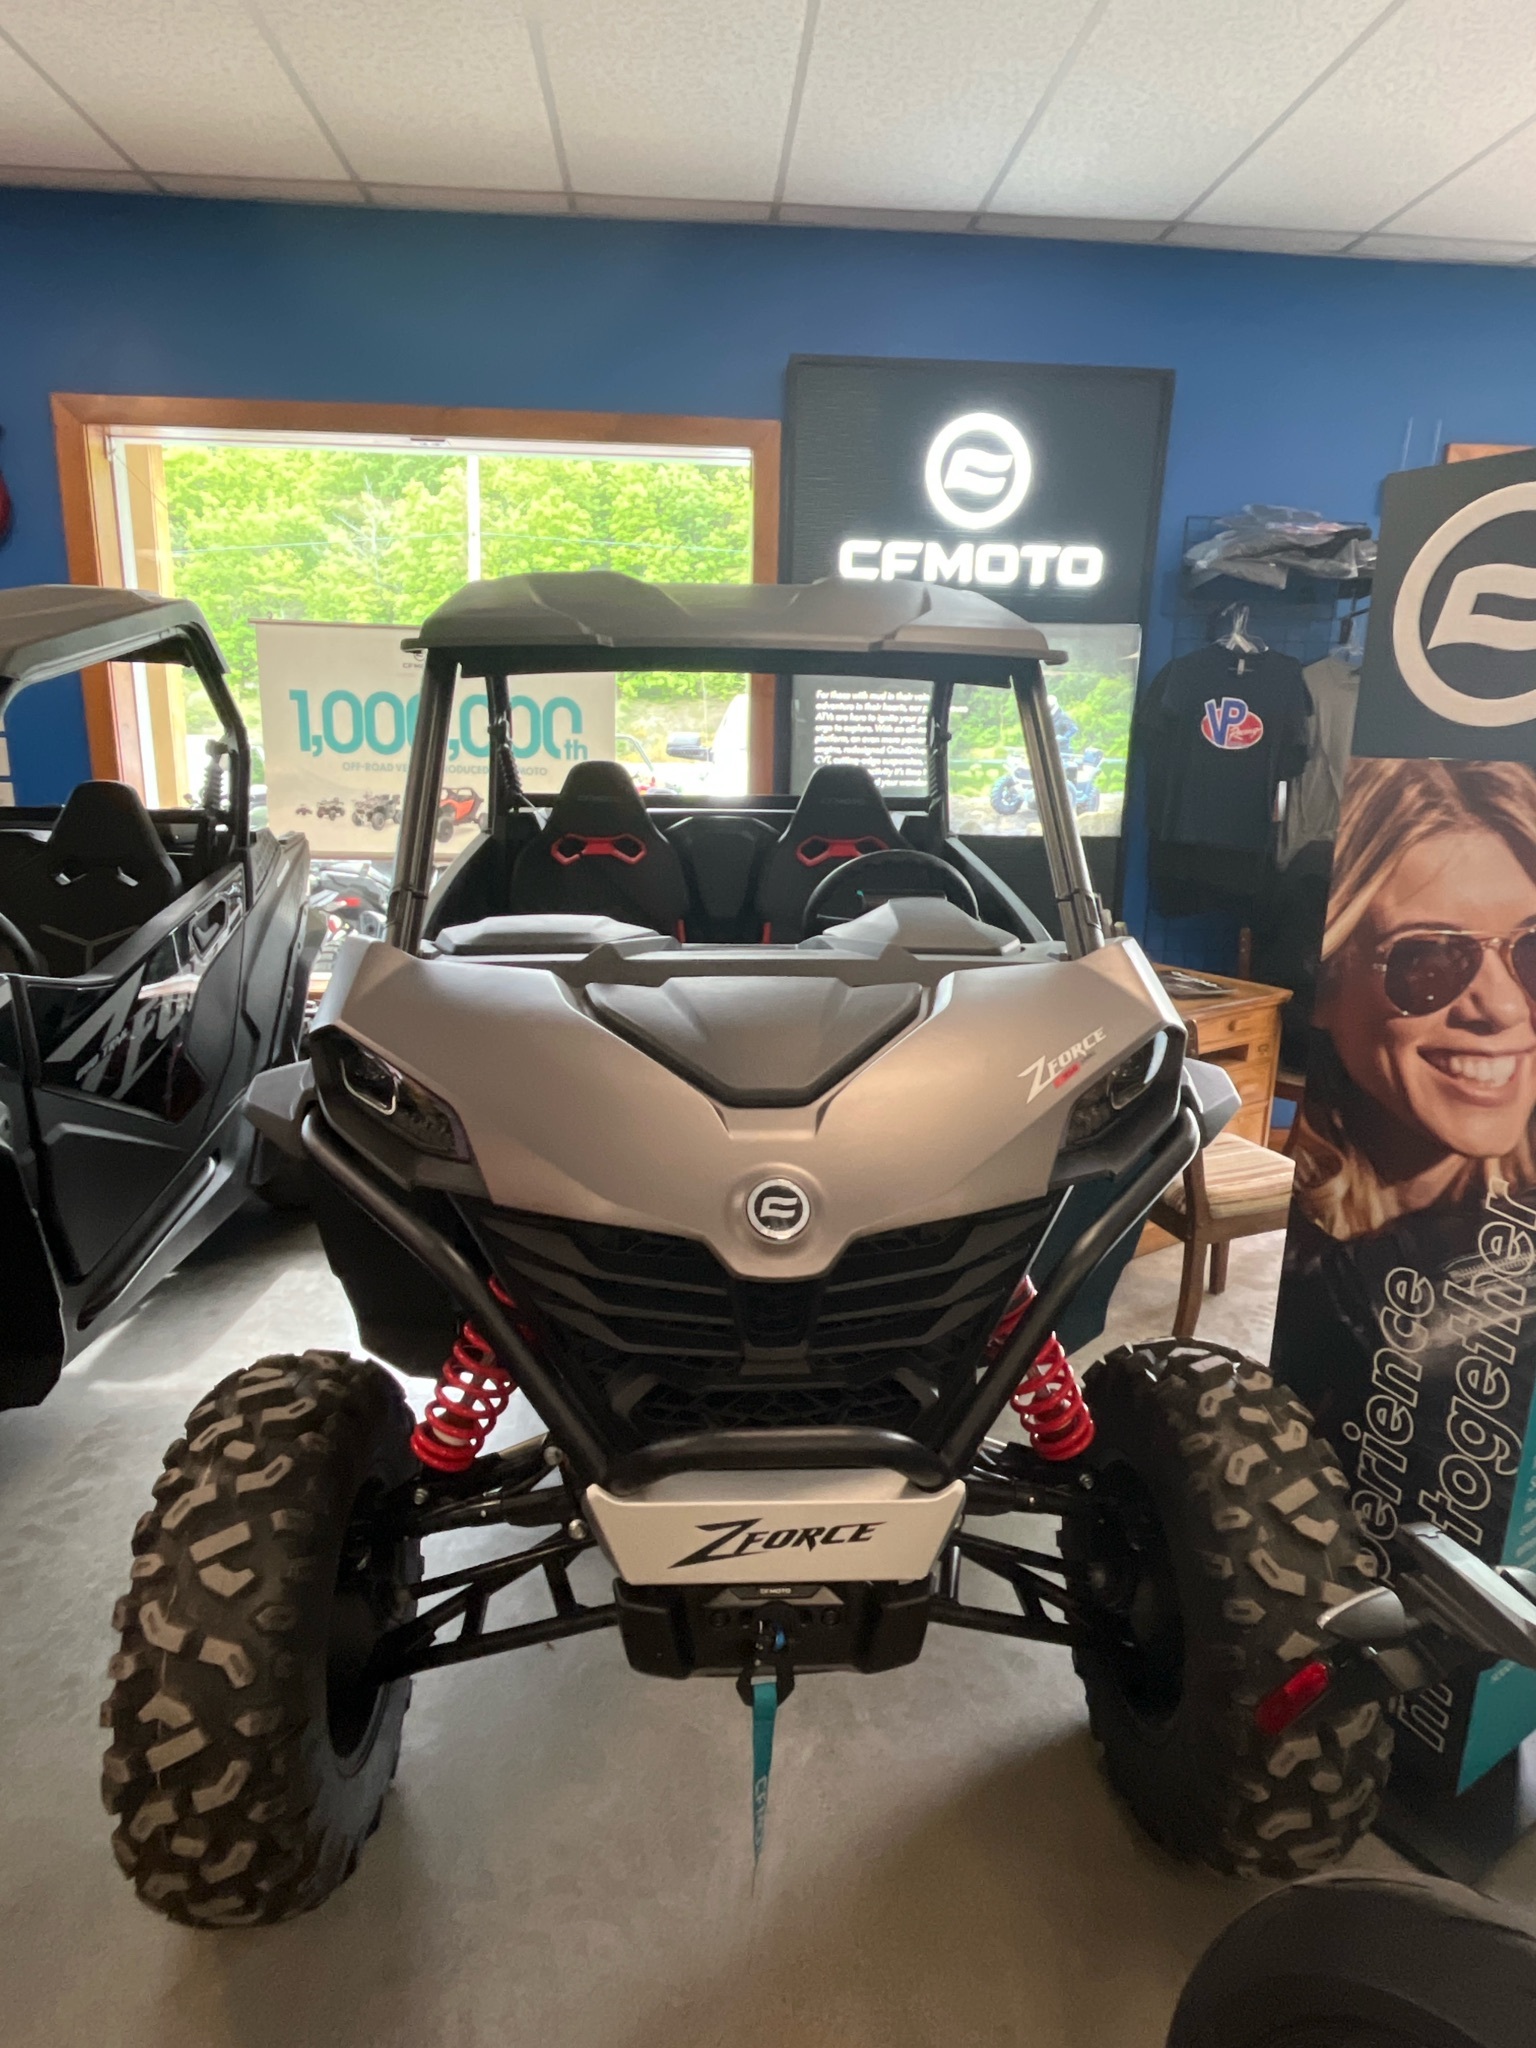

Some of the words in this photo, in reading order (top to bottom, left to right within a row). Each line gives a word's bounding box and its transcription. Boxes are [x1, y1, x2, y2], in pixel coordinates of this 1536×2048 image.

[838, 539, 1104, 587] CFMOTO
[1204, 697, 1249, 748] VP
[342, 761, 394, 772] OFF-ROAD
[446, 764, 490, 775] ODUCED
[519, 766, 548, 776] MOTO
[1017, 1026, 1107, 1104] ZFORCE
[1418, 1177, 1536, 1546] together
[1342, 1266, 1435, 1586] erience
[667, 1518, 887, 1568] ZFORCE
